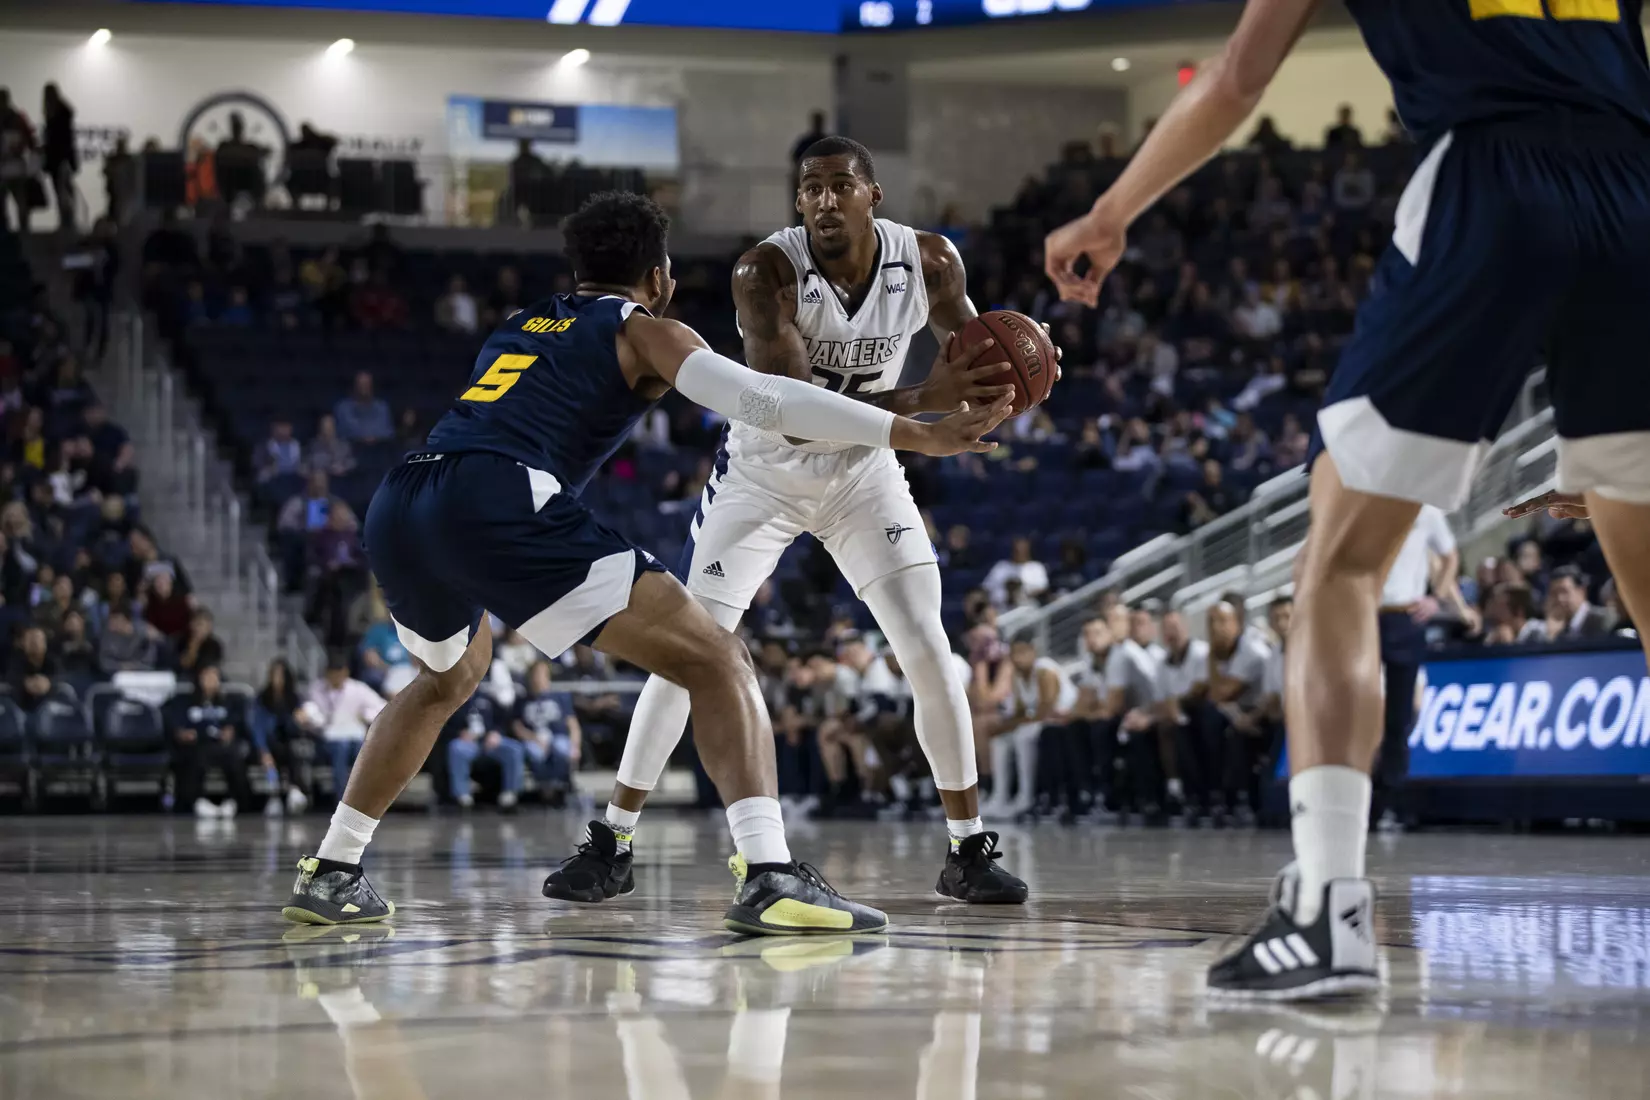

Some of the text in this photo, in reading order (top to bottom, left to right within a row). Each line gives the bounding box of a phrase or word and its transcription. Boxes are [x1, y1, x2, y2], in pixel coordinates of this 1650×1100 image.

[885, 282, 906, 295] WAC
[522, 316, 577, 333] GILES
[460, 353, 539, 402] 5
[702, 568, 725, 578] adidas
